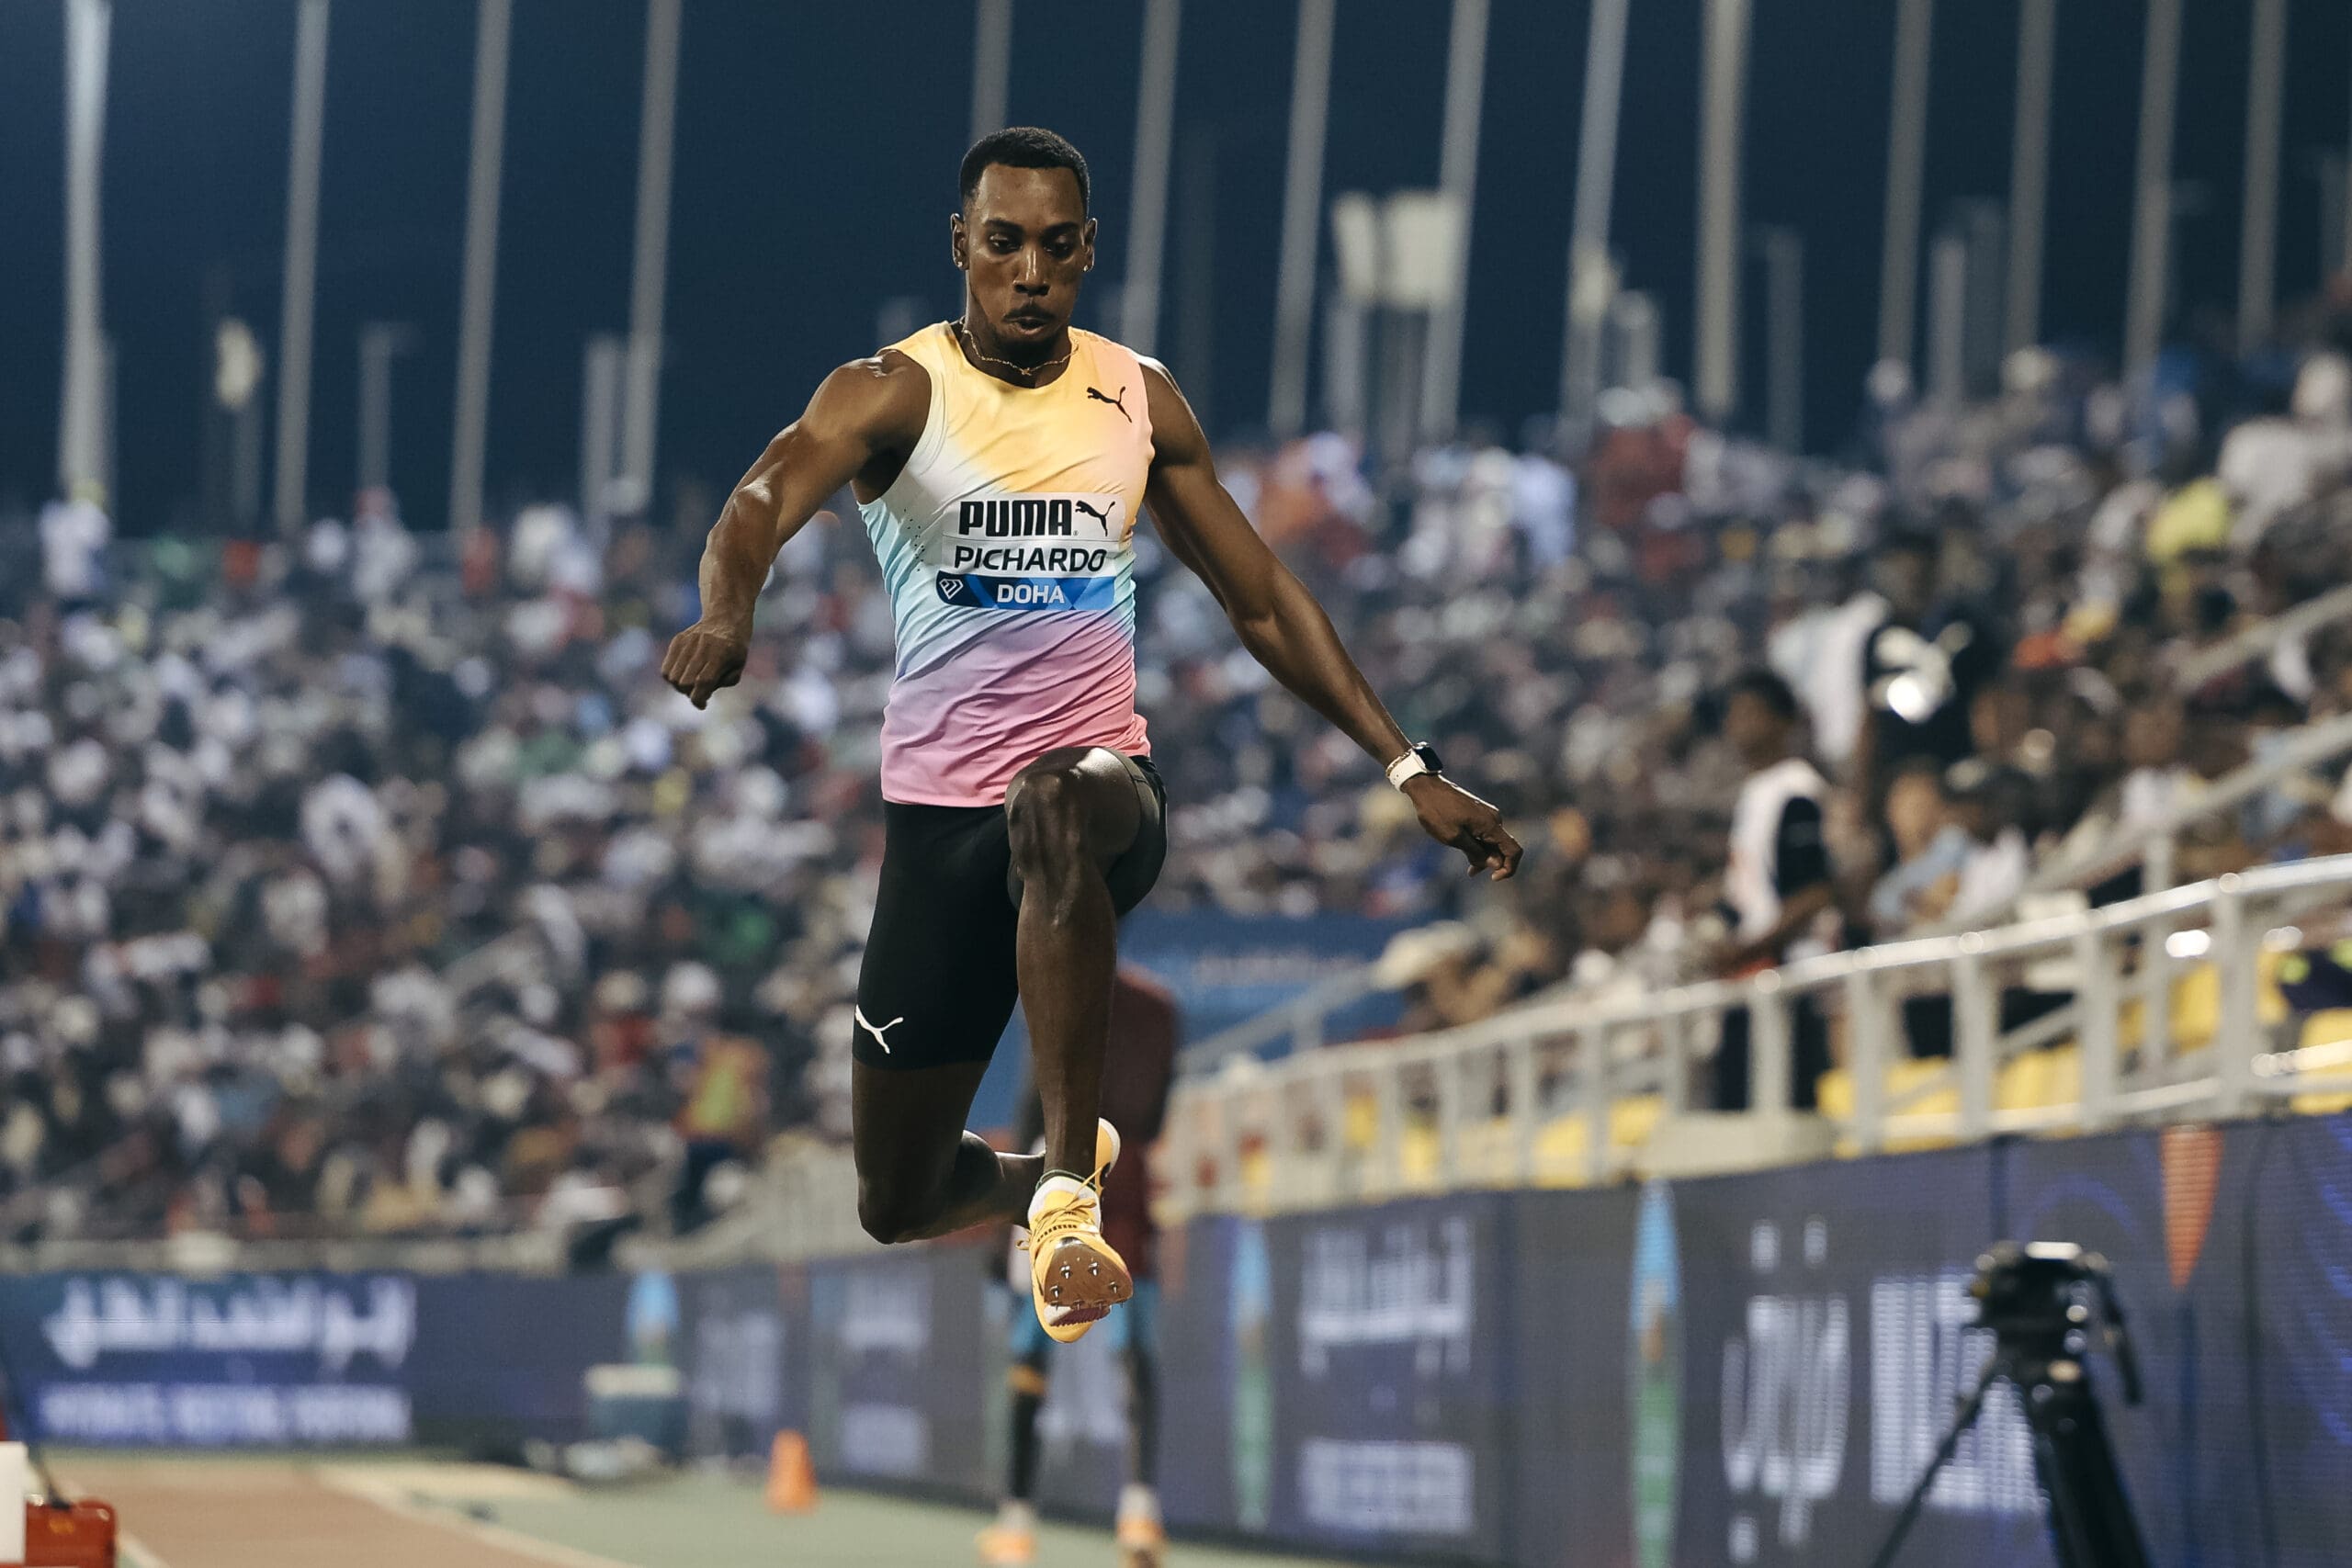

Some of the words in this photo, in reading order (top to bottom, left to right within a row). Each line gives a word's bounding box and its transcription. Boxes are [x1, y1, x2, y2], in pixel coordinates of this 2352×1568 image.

[958, 500, 1072, 536] PUMA
[954, 546, 1107, 571] PICHARDO
[997, 584, 1065, 604] DOHA
